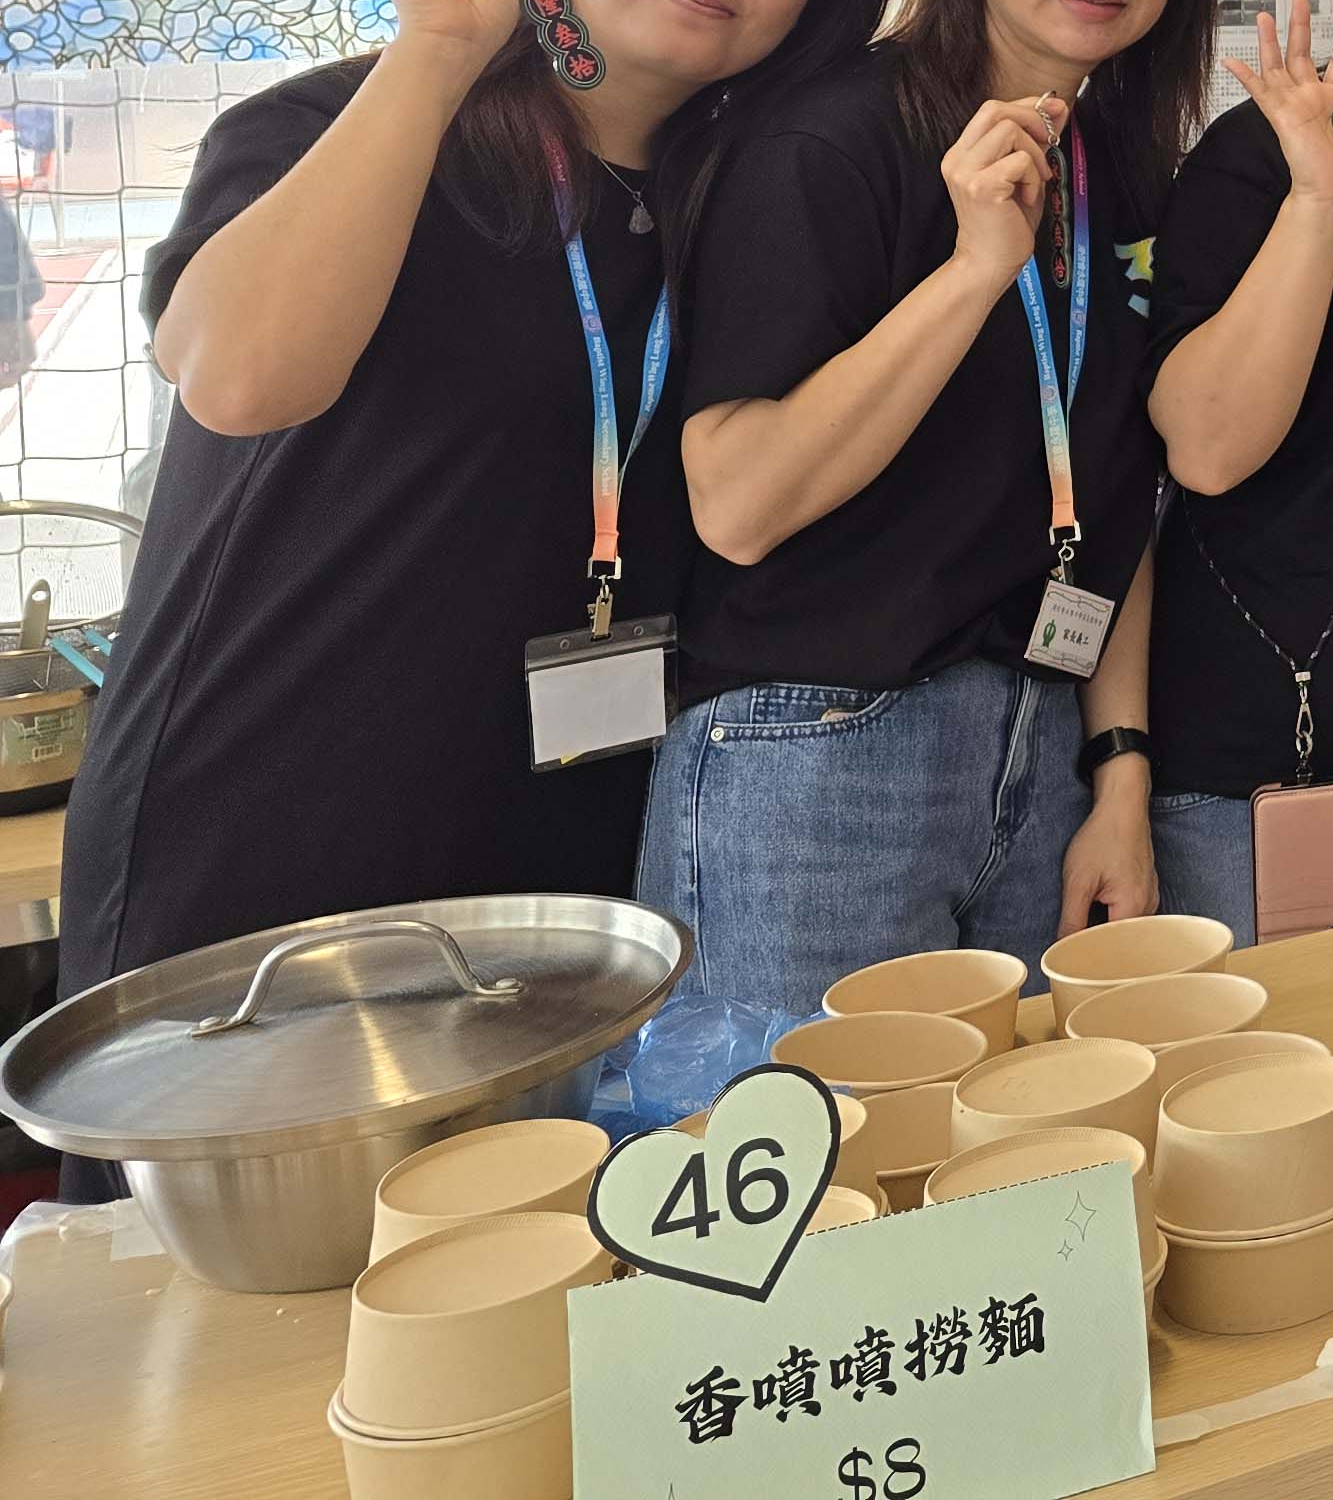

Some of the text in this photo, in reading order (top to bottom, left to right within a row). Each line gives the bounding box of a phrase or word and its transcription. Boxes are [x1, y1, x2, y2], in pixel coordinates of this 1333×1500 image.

[651, 1137, 790, 1240] 46
[674, 1292, 1046, 1444] 香噴噴撈麵
[837, 1437, 927, 1500] $8
